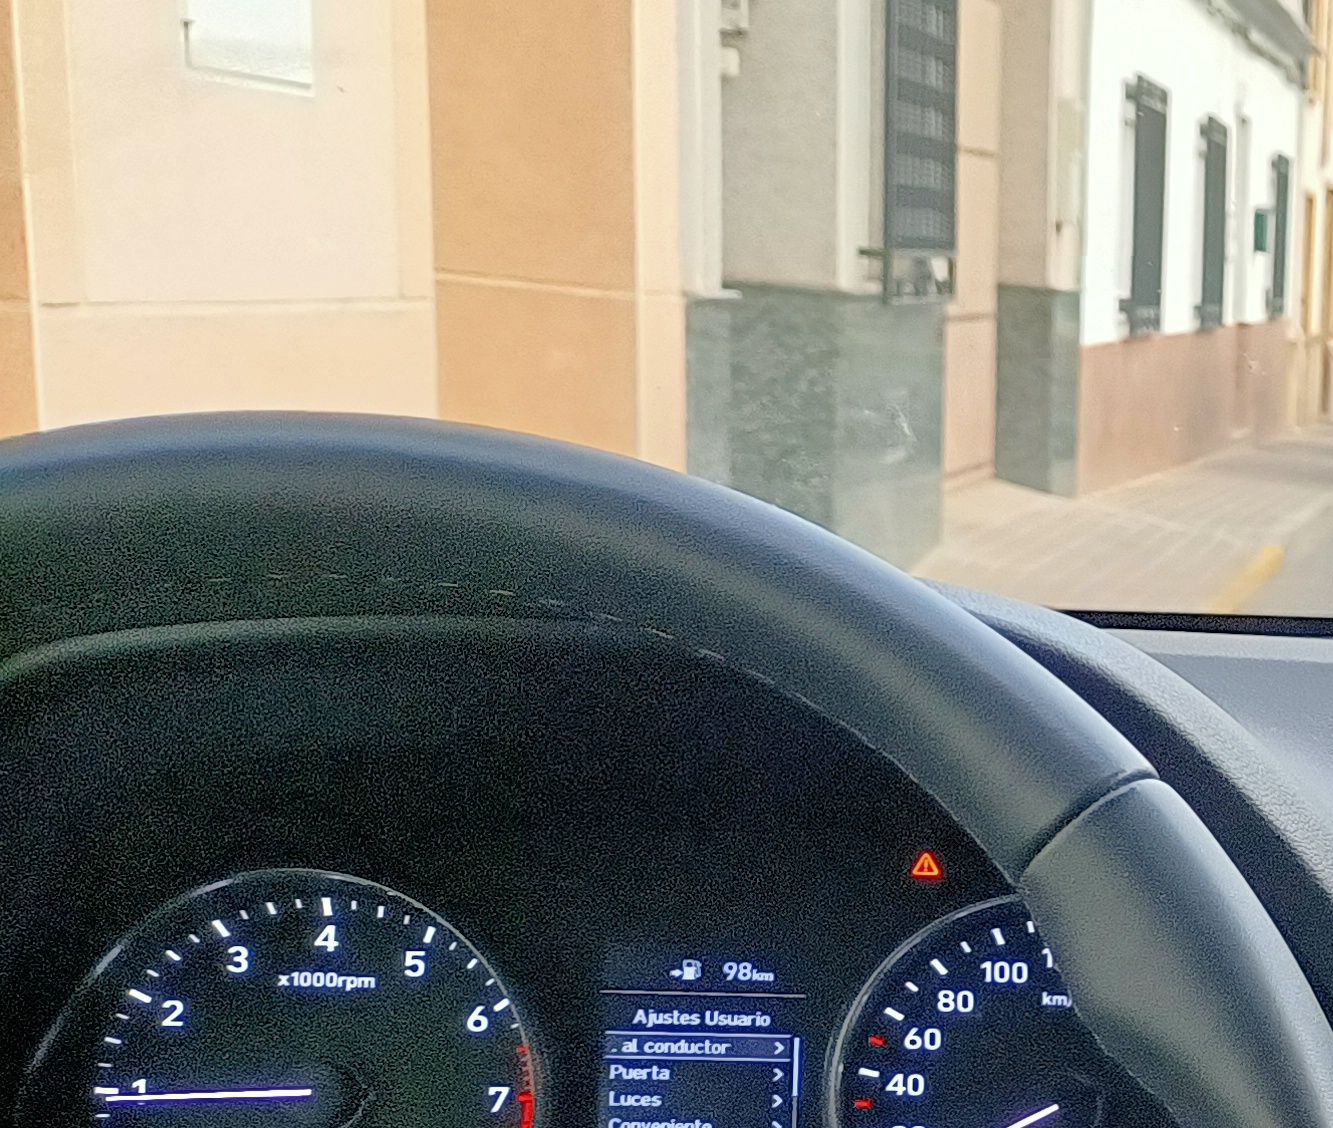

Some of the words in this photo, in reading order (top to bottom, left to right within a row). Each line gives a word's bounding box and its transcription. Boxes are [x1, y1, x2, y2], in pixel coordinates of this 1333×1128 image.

[314, 925, 338, 953] 4
[226, 946, 249, 973] 3
[404, 951, 426, 977] 5
[277, 971, 376, 992] x1000rpm
[980, 961, 1029, 984] 100
[937, 990, 974, 1012] 80
[1041, 991, 1072, 1008] km
[161, 1000, 184, 1027] 2
[467, 1006, 488, 1032] 6
[632, 1009, 701, 1028] Ajustes
[704, 1010, 771, 1027] Usuario
[621, 1038, 638, 1053] al
[643, 1039, 732, 1055] conductor
[904, 1027, 941, 1050] 60
[608, 1064, 671, 1081] Puerta
[131, 1078, 148, 1105] 1
[885, 1073, 925, 1096] 40
[487, 1086, 510, 1113] 7
[608, 1090, 662, 1107] Luces
